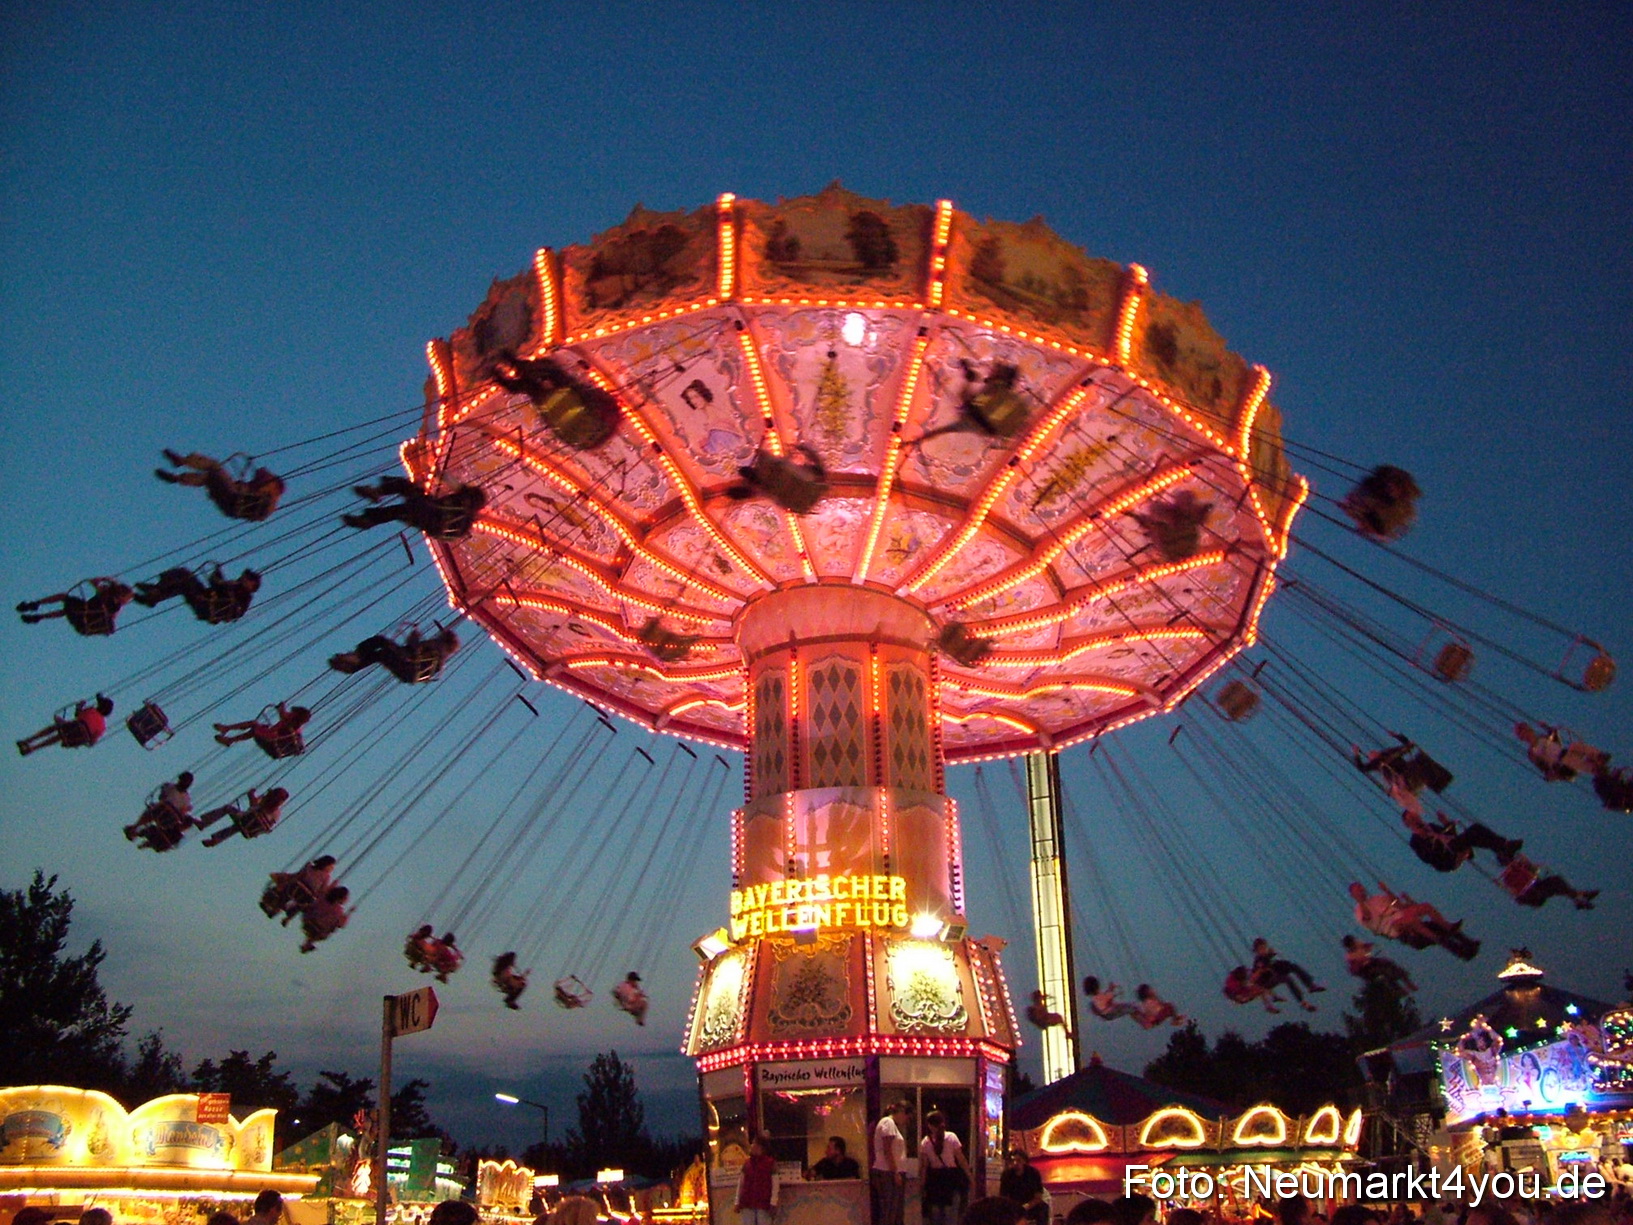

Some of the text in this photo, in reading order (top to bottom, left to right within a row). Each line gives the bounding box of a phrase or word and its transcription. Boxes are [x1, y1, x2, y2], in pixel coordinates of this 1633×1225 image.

[730, 875, 907, 915] BAYERISCHER
[730, 902, 909, 941] WELLENFLUG
[400, 993, 421, 1030] WC
